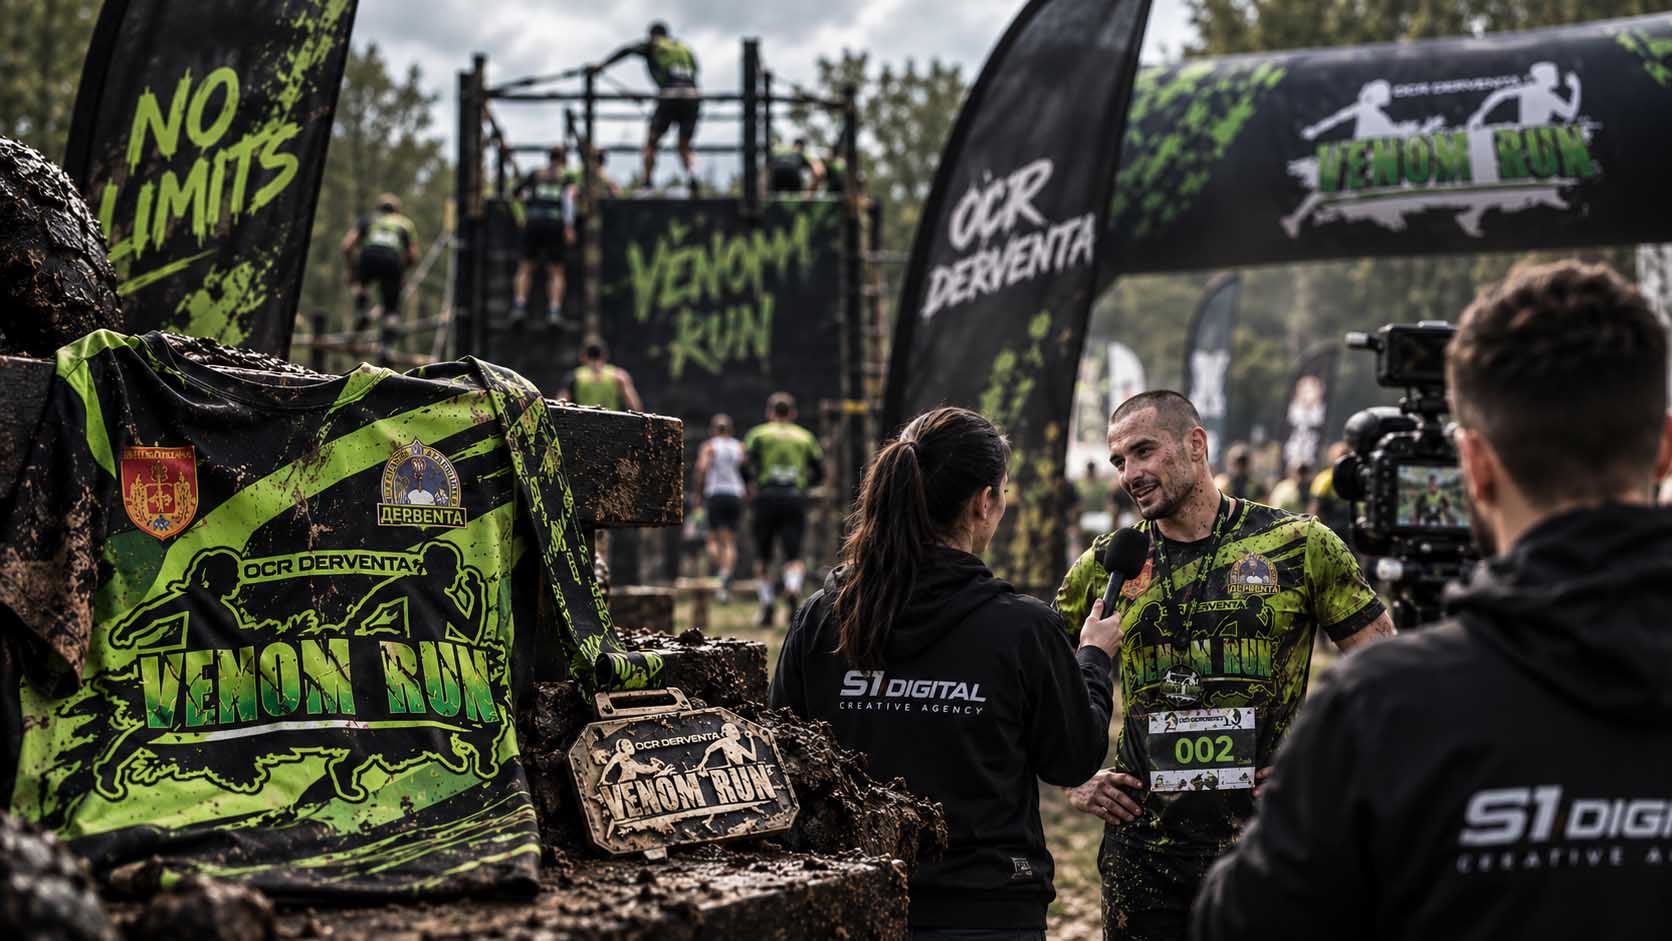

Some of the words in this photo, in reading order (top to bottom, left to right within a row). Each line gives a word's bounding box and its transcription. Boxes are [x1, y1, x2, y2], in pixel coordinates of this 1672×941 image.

[126, 66, 240, 176] NO
[1317, 131, 1472, 193] VENOM
[1493, 125, 1593, 179] RUN
[100, 121, 303, 261] LIMITS
[951, 158, 1054, 249] OCR
[921, 212, 1096, 319] DERVENTA
[669, 293, 775, 378] RUN
[244, 559, 293, 578] OCR
[298, 553, 412, 572] DERVENTA
[140, 638, 357, 729] VENOM
[379, 640, 500, 724] RUN
[839, 670, 885, 698] S1
[886, 679, 987, 703] DIGITAL
[1223, 638, 1273, 678] RUN
[839, 701, 912, 712] CREATIVE
[921, 704, 984, 716] AGENCY
[635, 740, 660, 751] OCR
[661, 731, 721, 748] DERVENTA
[1175, 735, 1235, 764] 002
[600, 771, 708, 822] VENOM
[709, 763, 778, 804] RUN
[1458, 784, 1562, 847] S1
